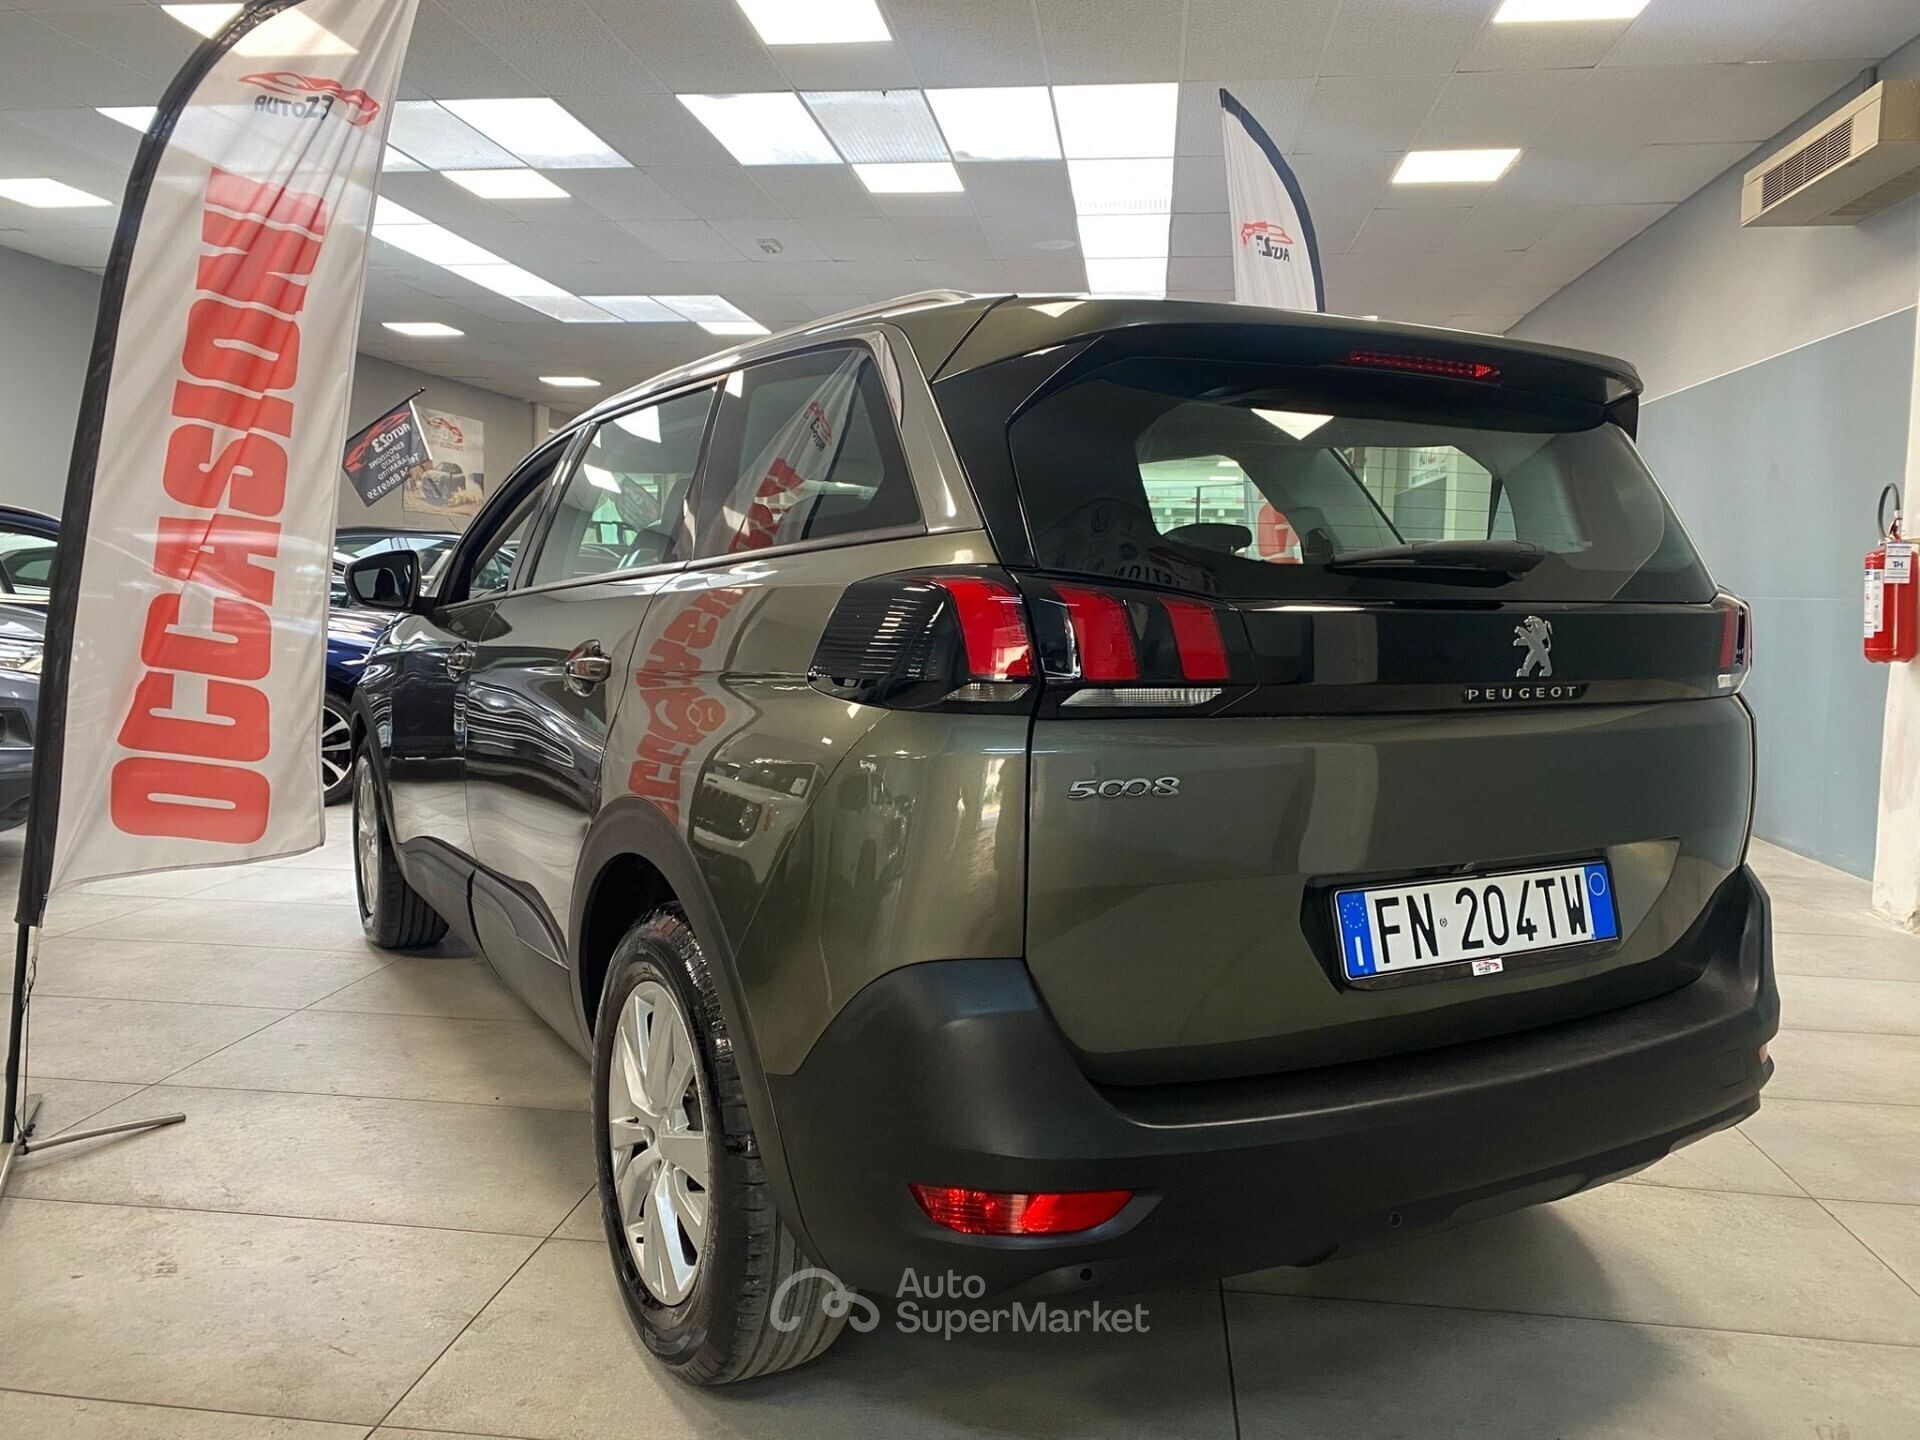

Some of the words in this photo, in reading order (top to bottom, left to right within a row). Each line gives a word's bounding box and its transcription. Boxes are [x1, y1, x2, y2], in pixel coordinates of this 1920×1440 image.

[111, 167, 328, 845] OCCASIONI
[1467, 686, 1577, 701] PEUGEOT
[1067, 776, 1181, 799] 5008
[1374, 892, 1439, 964] FN
[1455, 874, 1588, 951] 204TW
